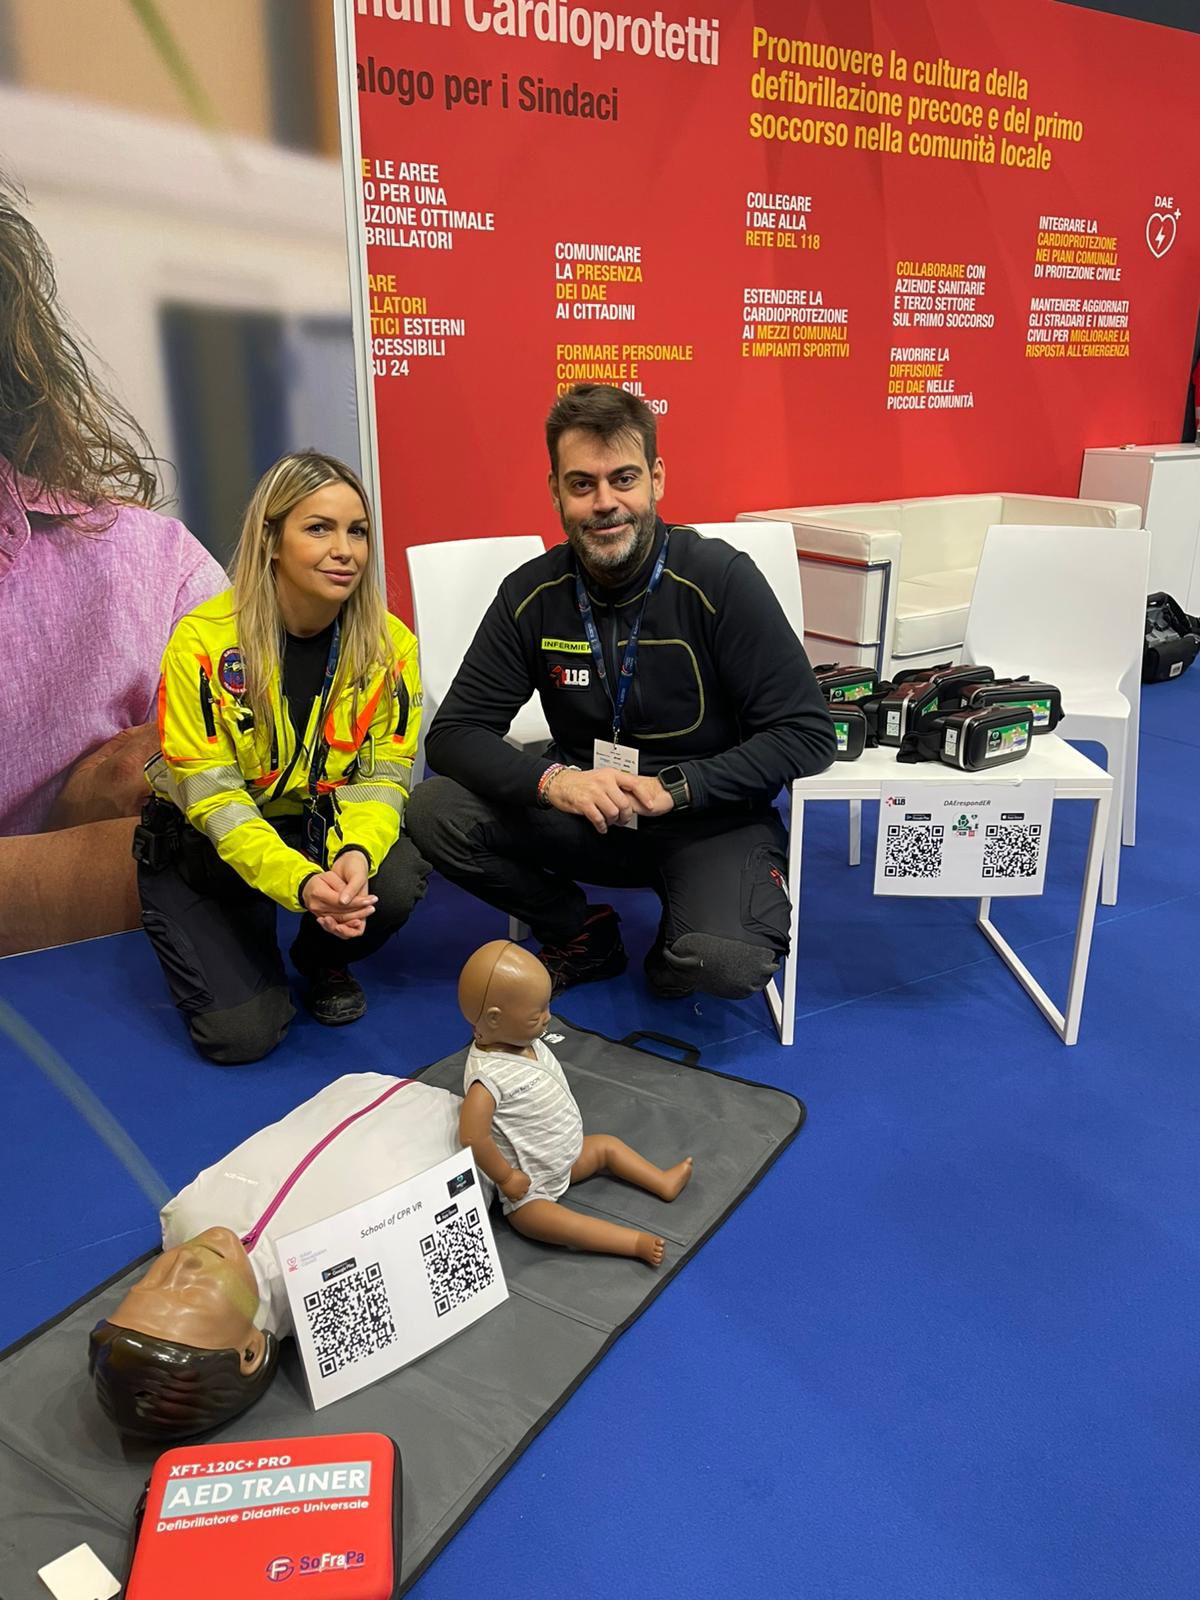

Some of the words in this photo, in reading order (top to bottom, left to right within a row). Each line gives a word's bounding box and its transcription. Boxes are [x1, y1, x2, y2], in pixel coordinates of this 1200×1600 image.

[357, 0, 451, 27] uni
[464, 0, 719, 66] Cardioprotetti
[753, 27, 883, 81] Promuovere
[890, 50, 907, 81] la
[913, 58, 980, 92] cultura
[986, 68, 1028, 100] della
[445, 73, 493, 110] per
[502, 73, 509, 109] i
[518, 75, 618, 121] Sindaci
[751, 67, 902, 117] defibrillazione
[908, 96, 983, 128] precoce
[988, 108, 999, 130] e
[1004, 105, 1030, 134] del
[1034, 112, 1083, 142] primo
[750, 113, 848, 147] soccorso
[854, 122, 902, 153] nella
[909, 132, 995, 163] comunità
[1000, 138, 1051, 170] locale
[375, 159, 395, 180] LE
[398, 162, 439, 183] AREE
[380, 183, 411, 203] PER
[414, 185, 447, 206] UNA
[747, 192, 812, 212] COLLEGARE
[1154, 195, 1173, 209] DAE
[420, 208, 495, 231] OTTIMALE
[746, 211, 750, 227] I
[753, 212, 776, 228] DAE
[778, 213, 807, 230] ALLA
[1039, 216, 1086, 233] INTEGRARE
[1087, 220, 1097, 234] LA
[746, 230, 774, 247] RETE
[777, 232, 797, 248] DEL
[801, 234, 820, 249] 118
[1038, 232, 1117, 250] CARDIOPROTEZIONE
[555, 242, 641, 263] COMUNICARE
[1036, 248, 1050, 262] NEI
[1052, 249, 1074, 263] PIANI
[1076, 251, 1117, 266] COMUNALI
[556, 262, 573, 280] LA
[576, 264, 643, 282] PRESENZA
[896, 261, 965, 278] COLLABORARE
[966, 264, 986, 279] CON
[1034, 264, 1044, 278] DI
[1045, 264, 1095, 280] PROTEZIONE
[1096, 267, 1121, 281] CIVILE
[556, 283, 577, 300] DEI
[581, 284, 607, 300] DAE
[895, 278, 936, 294] AZIENDE
[937, 280, 986, 296] SANITARIE
[744, 288, 807, 305] ESTENDERE
[809, 290, 823, 305] LA
[894, 295, 901, 310] E
[903, 295, 933, 311] TERZO
[934, 296, 976, 311] SETTORE
[1030, 298, 1081, 312] MANTENERE
[1081, 299, 1129, 313] AGGIORNATI
[555, 303, 569, 319] AI
[573, 303, 635, 320] CITTADINI
[743, 306, 848, 323] CARDIOPROTEZIONE
[892, 312, 911, 327] SUL
[913, 313, 944, 327] PRIMO
[946, 313, 994, 328] SOCCORSO
[1029, 313, 1043, 327] GLI
[1044, 313, 1085, 327] STRADARI
[1086, 314, 1092, 327] E
[1097, 315, 1128, 328] NUMERI
[404, 318, 465, 336] ESTERNI
[742, 324, 755, 339] AI
[757, 325, 790, 340] MEZZI
[793, 325, 847, 340] COMUNALI
[1027, 329, 1052, 342] CIVILI
[1052, 329, 1069, 342] PER
[1070, 330, 1119, 342] MIGLIORARE
[1120, 330, 1129, 342] LA
[557, 344, 619, 360] FORMARE
[622, 345, 693, 360] PERSONALE
[742, 342, 749, 357] E
[752, 342, 801, 357] IMPIANTI
[803, 343, 849, 357] SPORTIVI
[890, 347, 936, 362] FAVORIRE
[937, 348, 950, 362] LA
[1026, 344, 1065, 357] RISPOSTA
[1066, 344, 1129, 357] ALL'EMERGENZA
[390, 359, 409, 376] 24
[557, 363, 627, 379] COMUNALE
[630, 363, 638, 379] E
[890, 364, 944, 377] DIFFUSIONE
[622, 382, 645, 397] SUL
[888, 380, 904, 393] DEI
[906, 380, 925, 393] DAE
[926, 379, 955, 393] NELLE
[887, 395, 927, 410] PICCOLE
[927, 392, 974, 409] COMUNITÀ
[564, 669, 590, 686] 118
[360, 1219, 386, 1239] School
[387, 1213, 396, 1226] of
[396, 1207, 411, 1221] CPR
[412, 1200, 423, 1212] VR
[170, 1459, 255, 1477] XFT-120C+
[257, 1455, 292, 1469] PRO
[167, 1482, 234, 1509] AED
[241, 1469, 365, 1500] TRAINER
[156, 1512, 239, 1533] Defibrillatore
[242, 1505, 300, 1521] Didattico
[303, 1499, 369, 1514] Universale
[300, 1551, 365, 1571] SoFraPa
